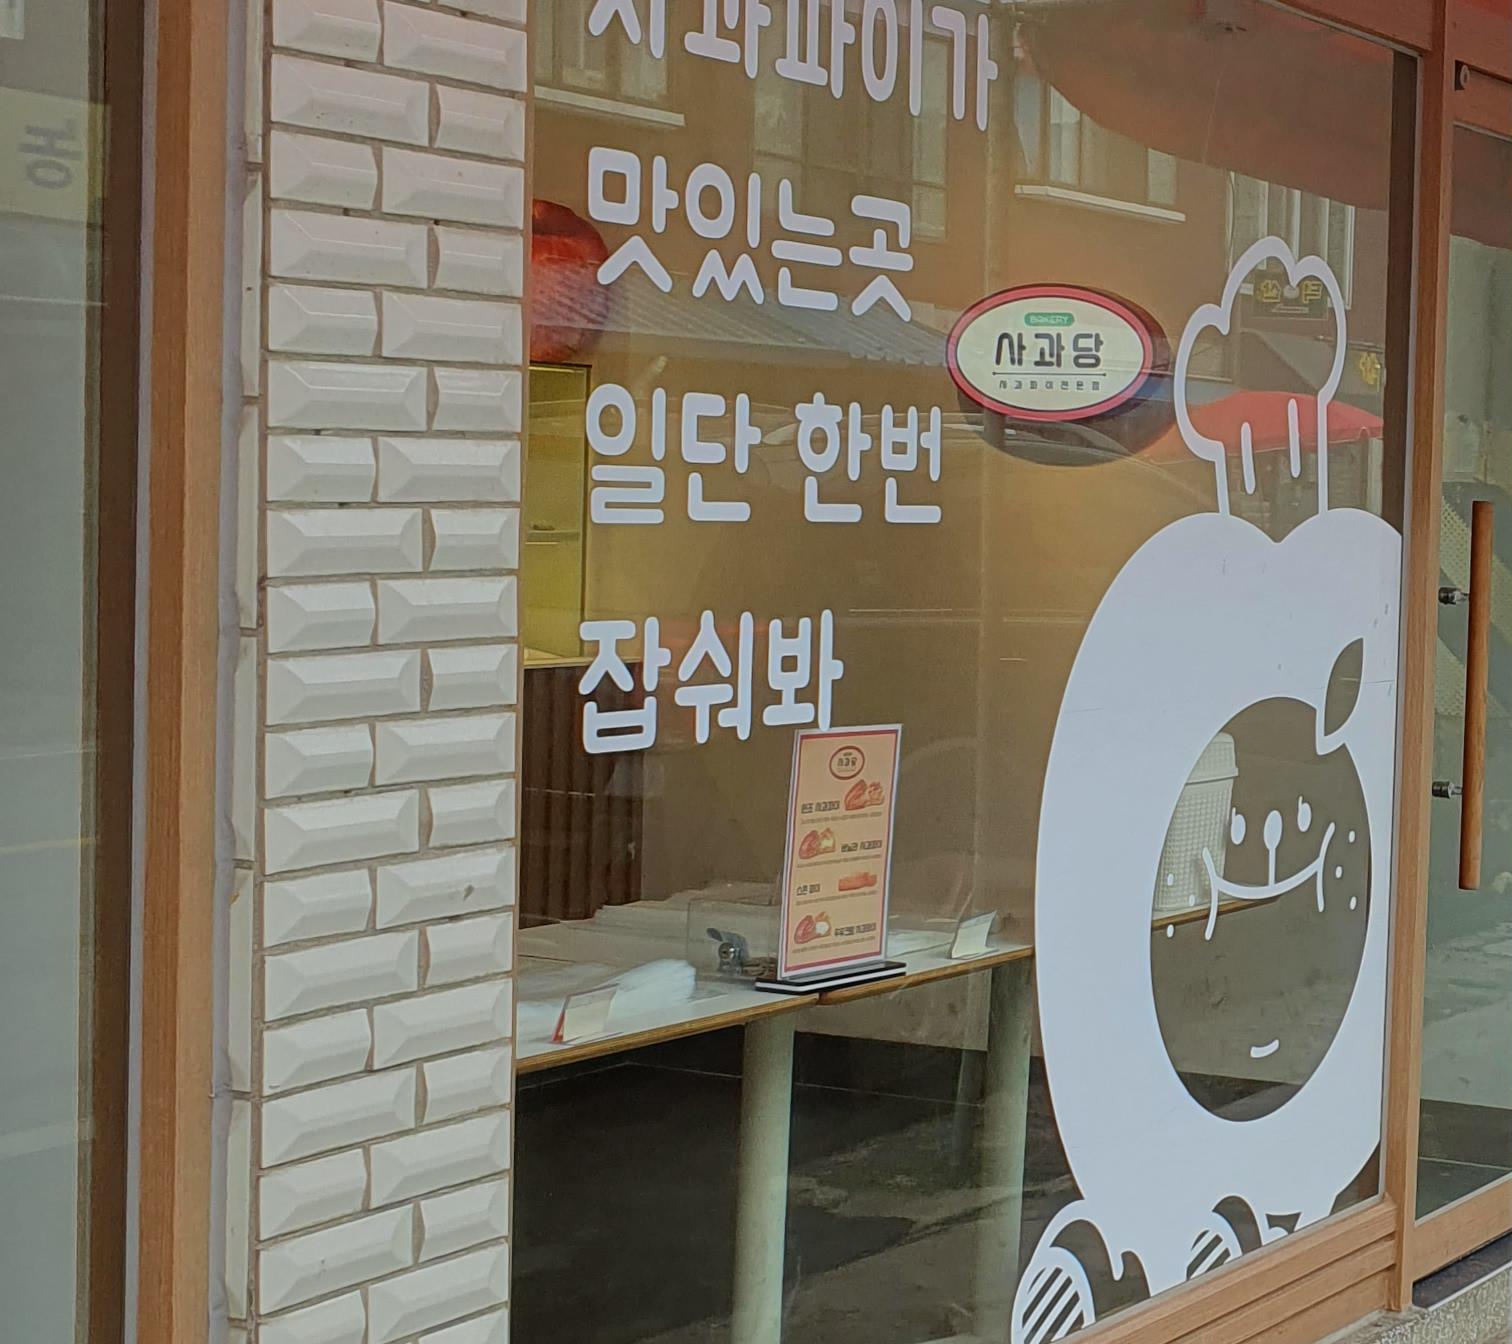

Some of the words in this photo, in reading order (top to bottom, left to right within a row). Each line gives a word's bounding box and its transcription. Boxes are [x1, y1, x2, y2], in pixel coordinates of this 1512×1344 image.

[589, 148, 913, 321] 맛있는곳
[994, 331, 1105, 369] 사과당
[586, 384, 761, 523] 일단
[795, 393, 941, 523] 한번
[578, 608, 845, 755] 잡쉬봐
